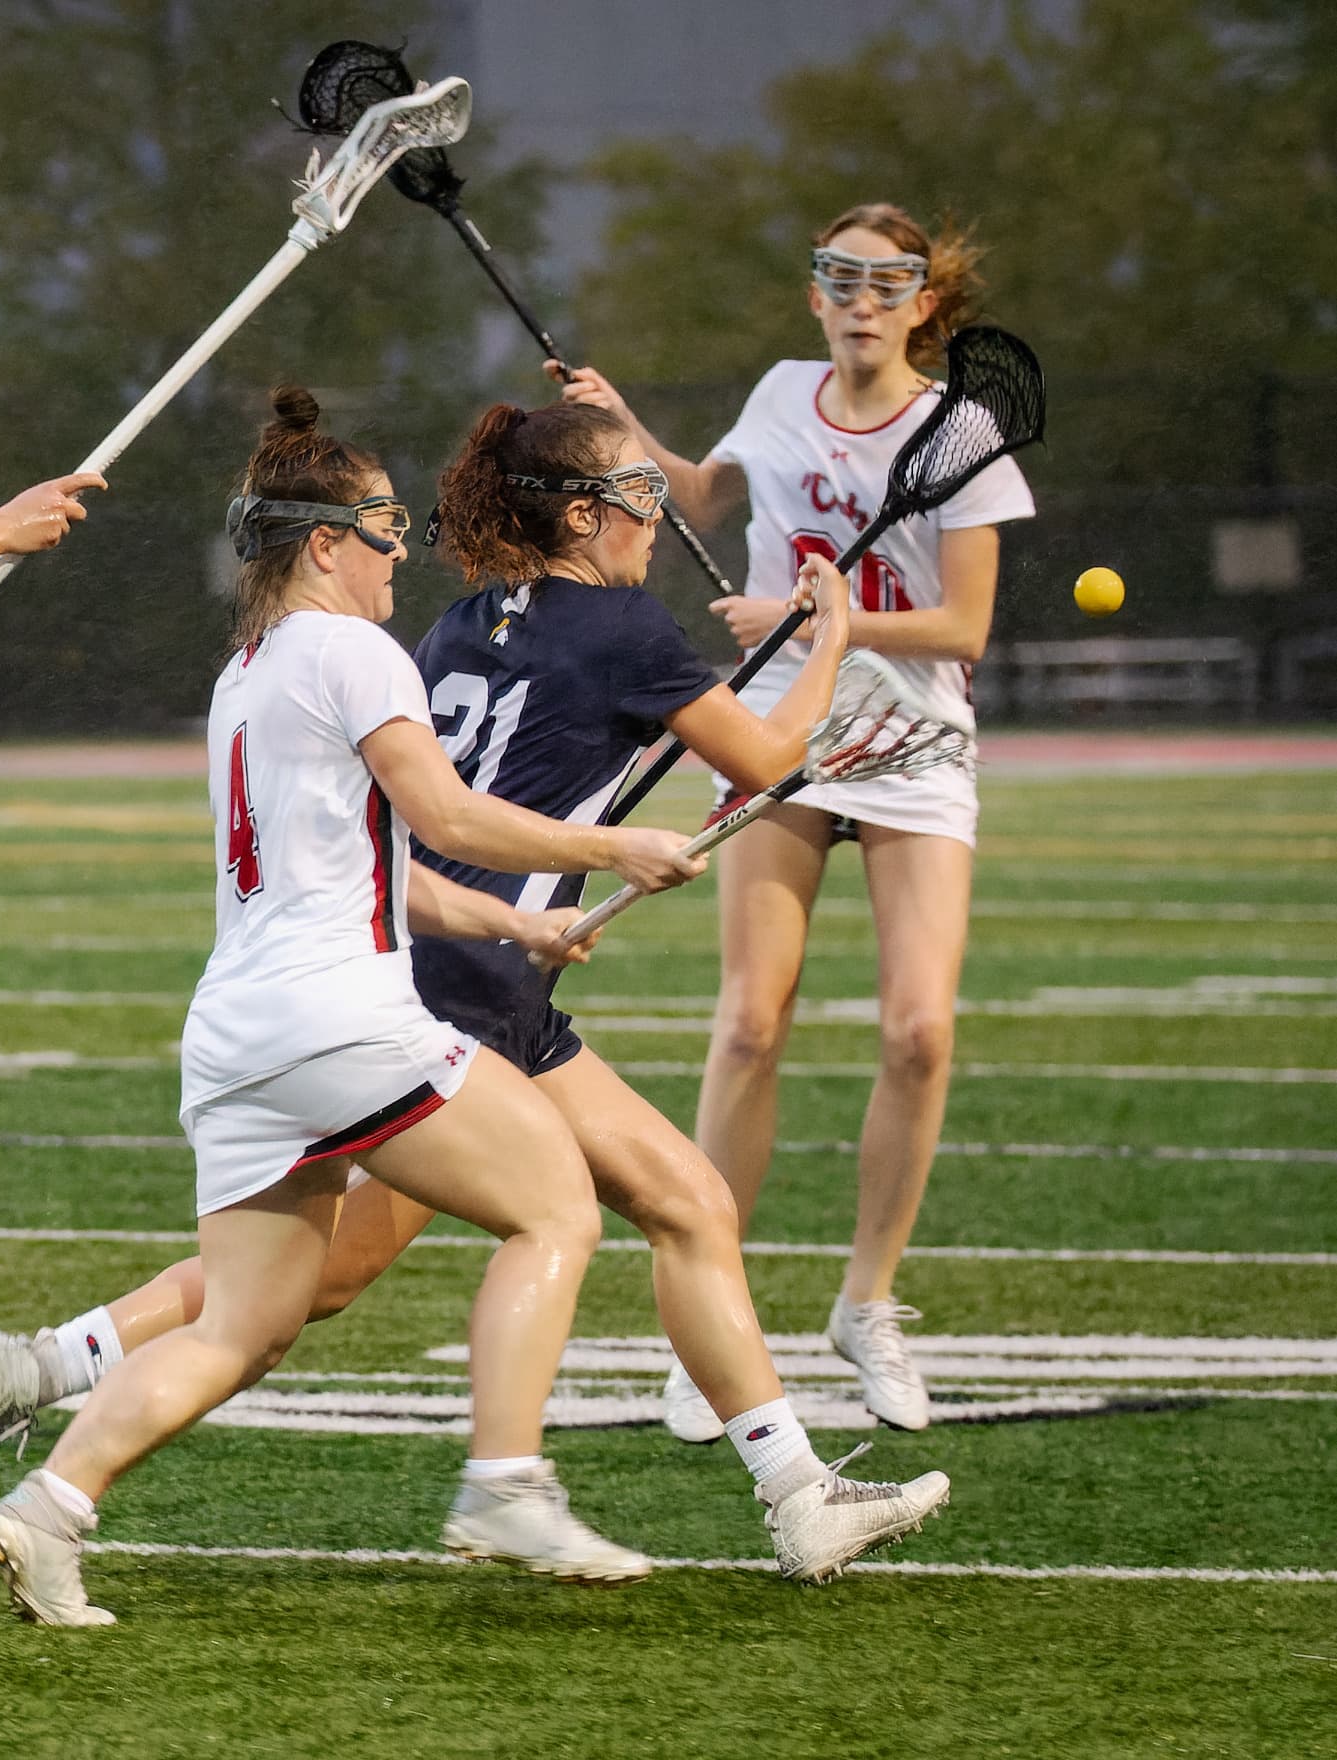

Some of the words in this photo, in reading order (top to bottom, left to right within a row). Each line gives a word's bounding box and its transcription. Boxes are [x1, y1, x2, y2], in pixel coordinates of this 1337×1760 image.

[505, 473, 546, 490] STX
[563, 478, 608, 492] STX
[430, 670, 531, 794] 21
[227, 719, 264, 904] 4
